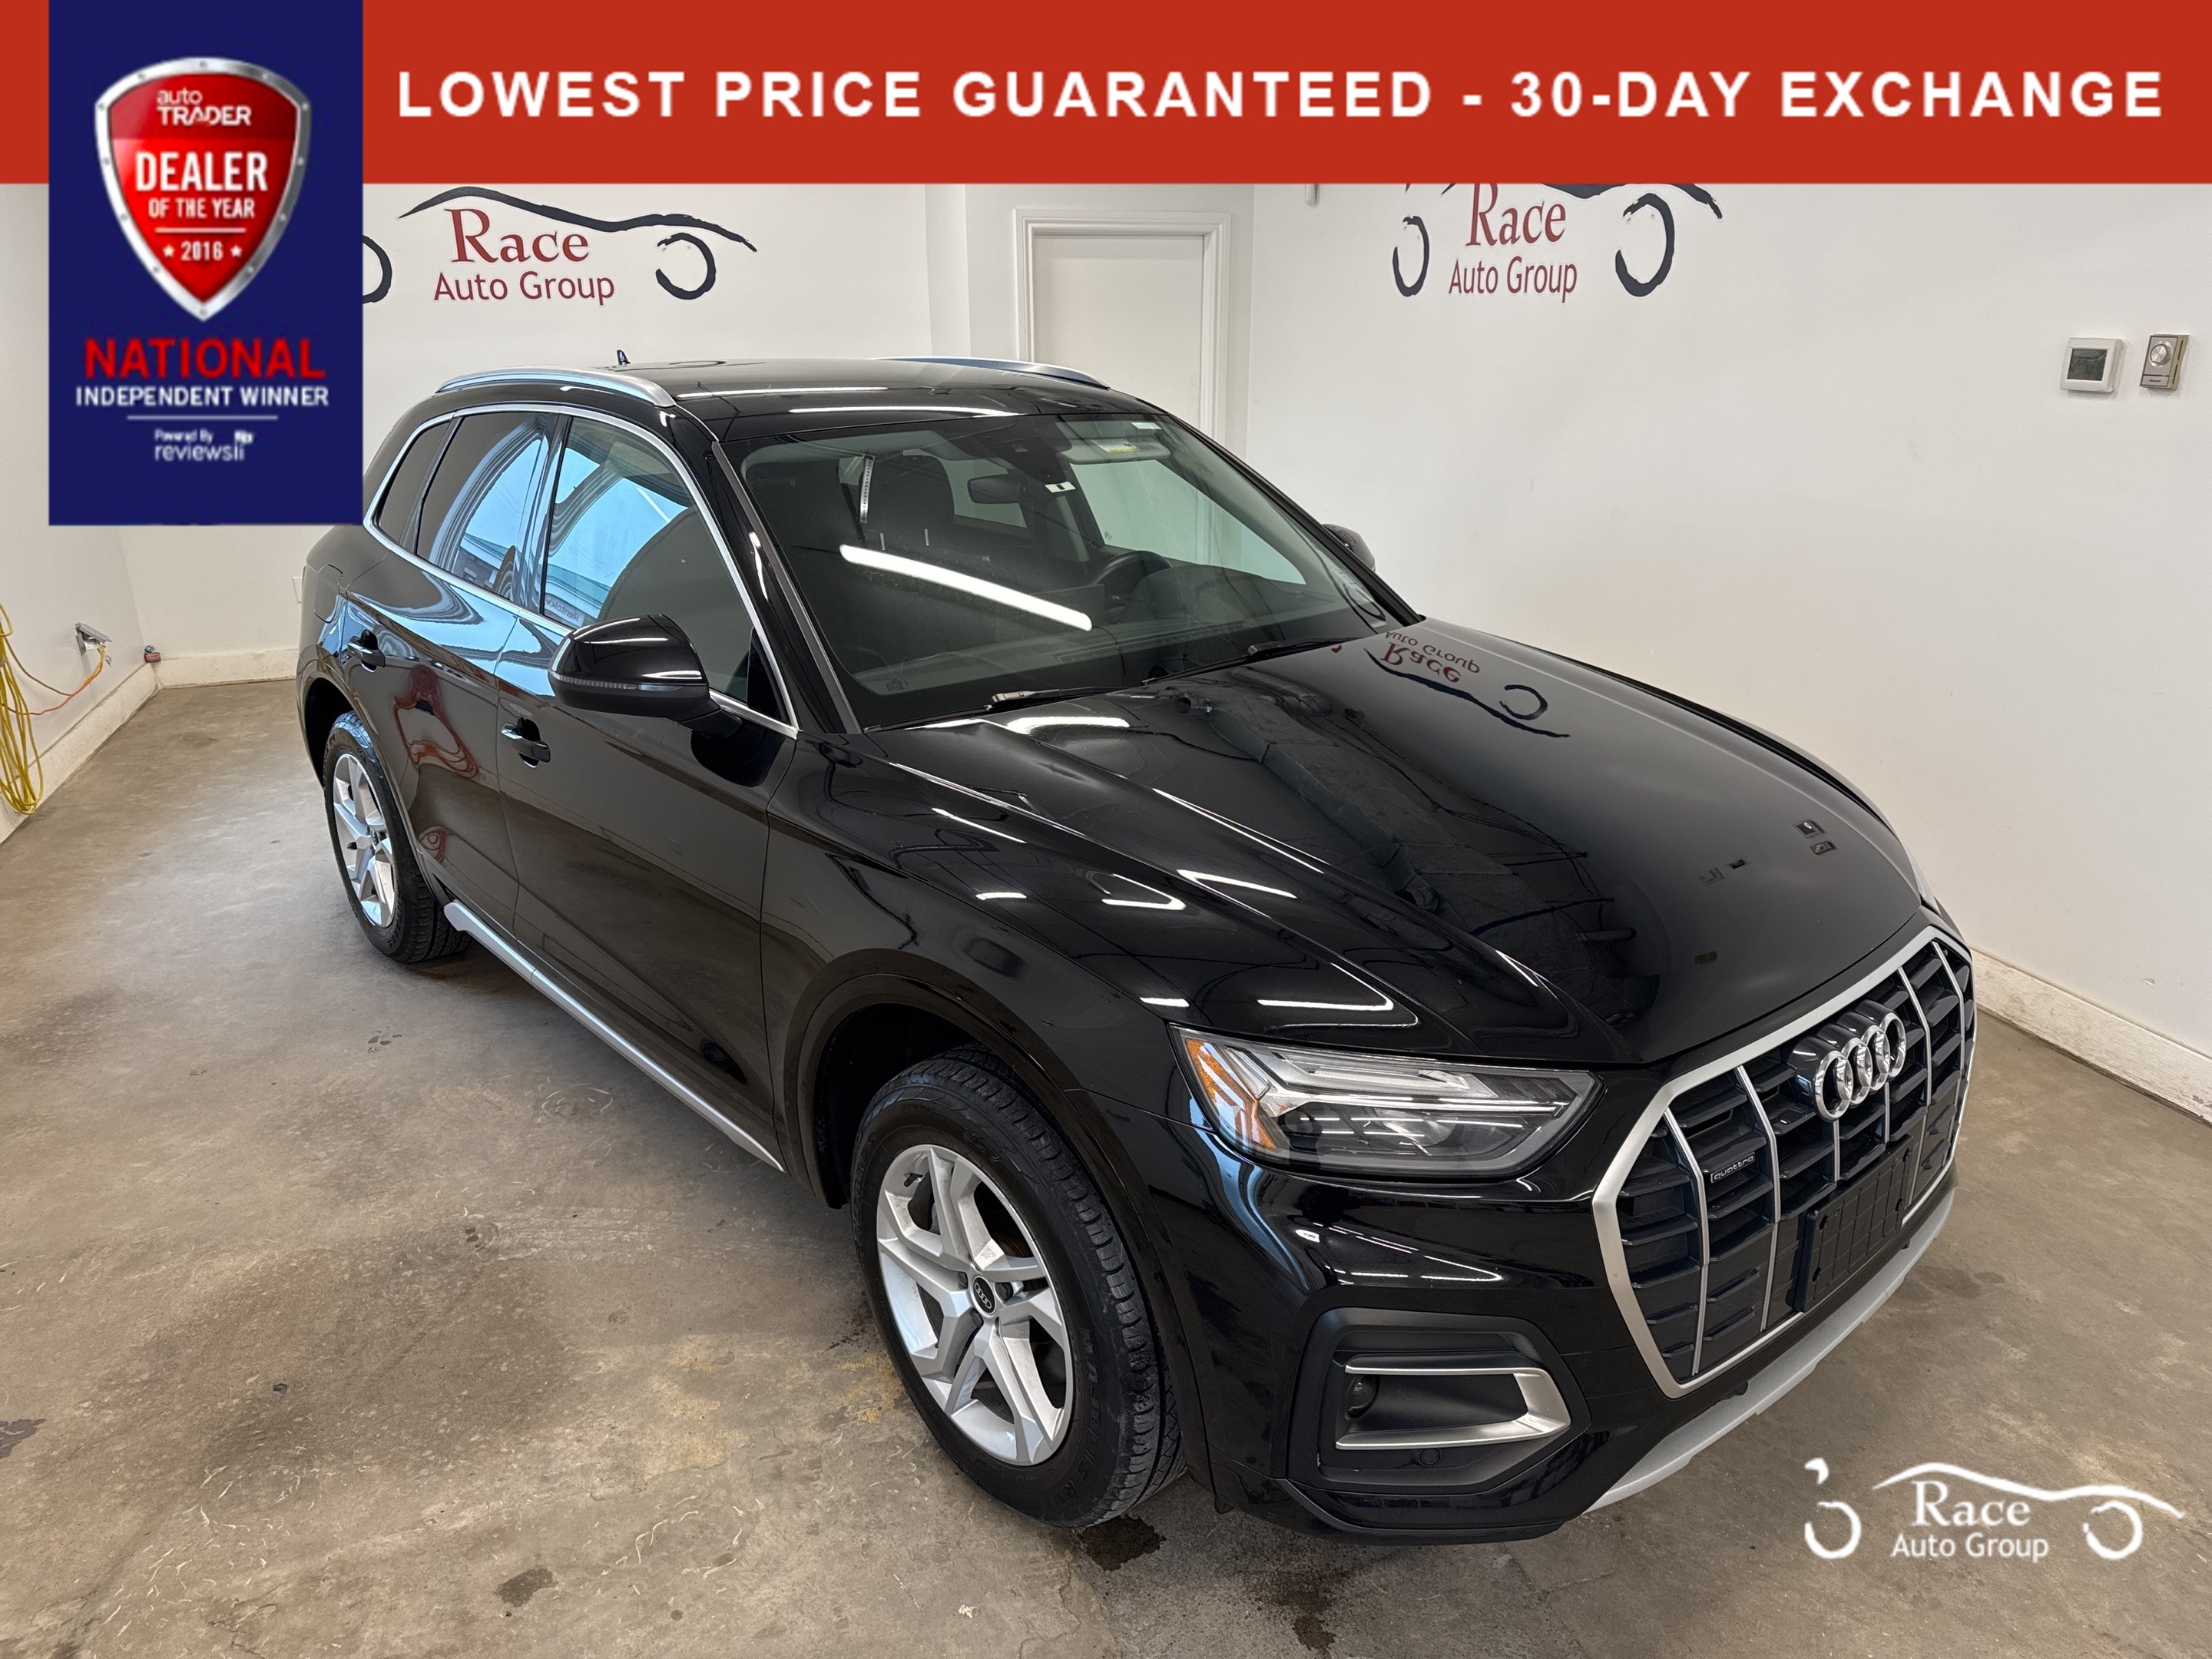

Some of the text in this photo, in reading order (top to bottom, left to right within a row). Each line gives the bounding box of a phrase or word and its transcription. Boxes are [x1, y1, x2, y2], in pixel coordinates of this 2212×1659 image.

[445, 208, 590, 264] Race
[1466, 184, 1567, 247] Race
[434, 271, 615, 305] Auto Group
[1449, 256, 1578, 303] Auto Group
[1714, 1155, 1754, 1181] quattro
